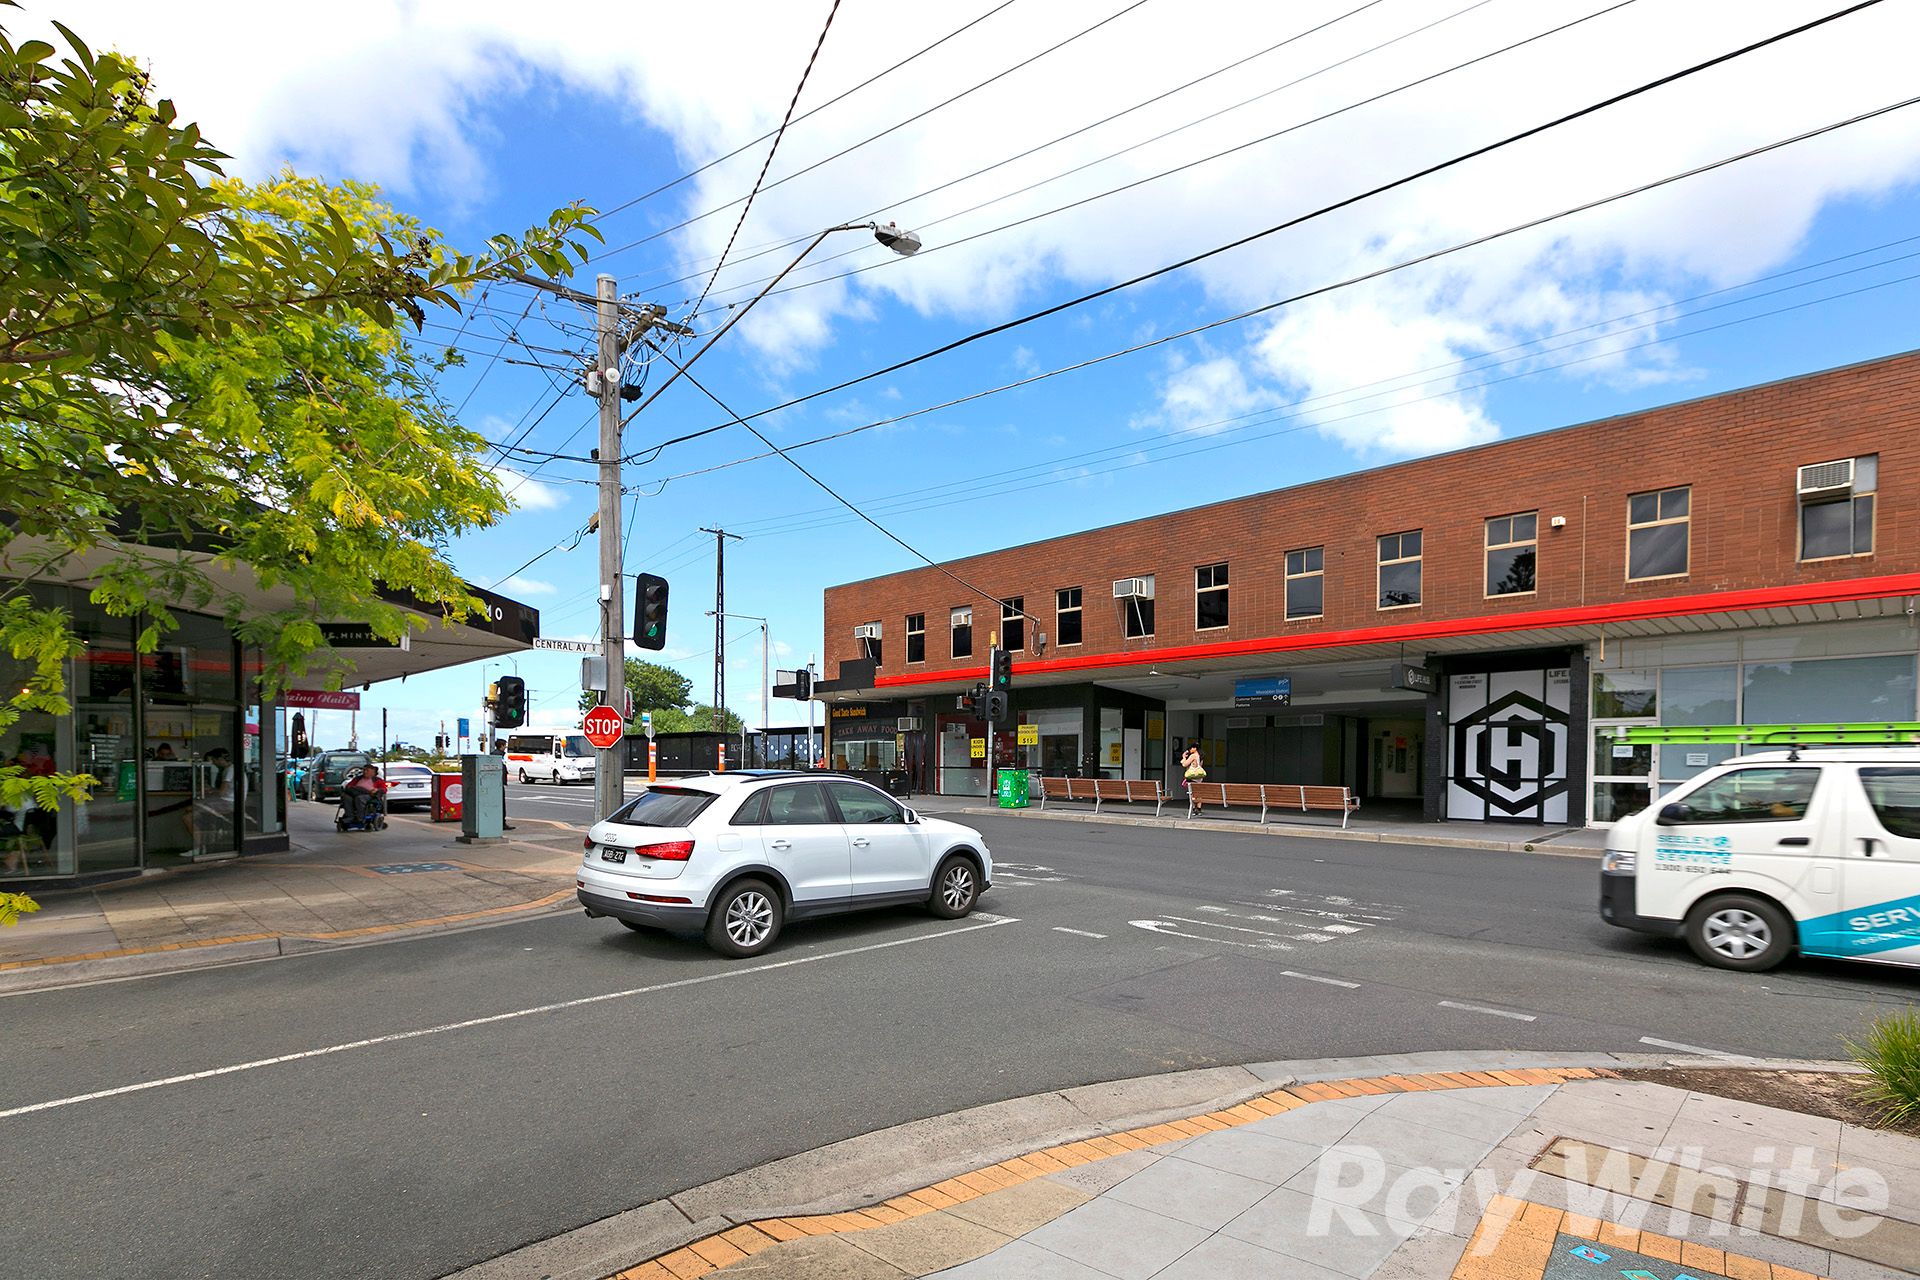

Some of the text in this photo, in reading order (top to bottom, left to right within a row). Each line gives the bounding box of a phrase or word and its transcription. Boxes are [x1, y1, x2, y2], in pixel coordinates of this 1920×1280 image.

[535, 639, 573, 651] CENTRAL
[576, 643, 588, 652] AV
[287, 693, 350, 704] zing Nails
[586, 719, 621, 735] STOP
[857, 725, 877, 734] AWAY
[1656, 853, 1732, 865] SERVICE
